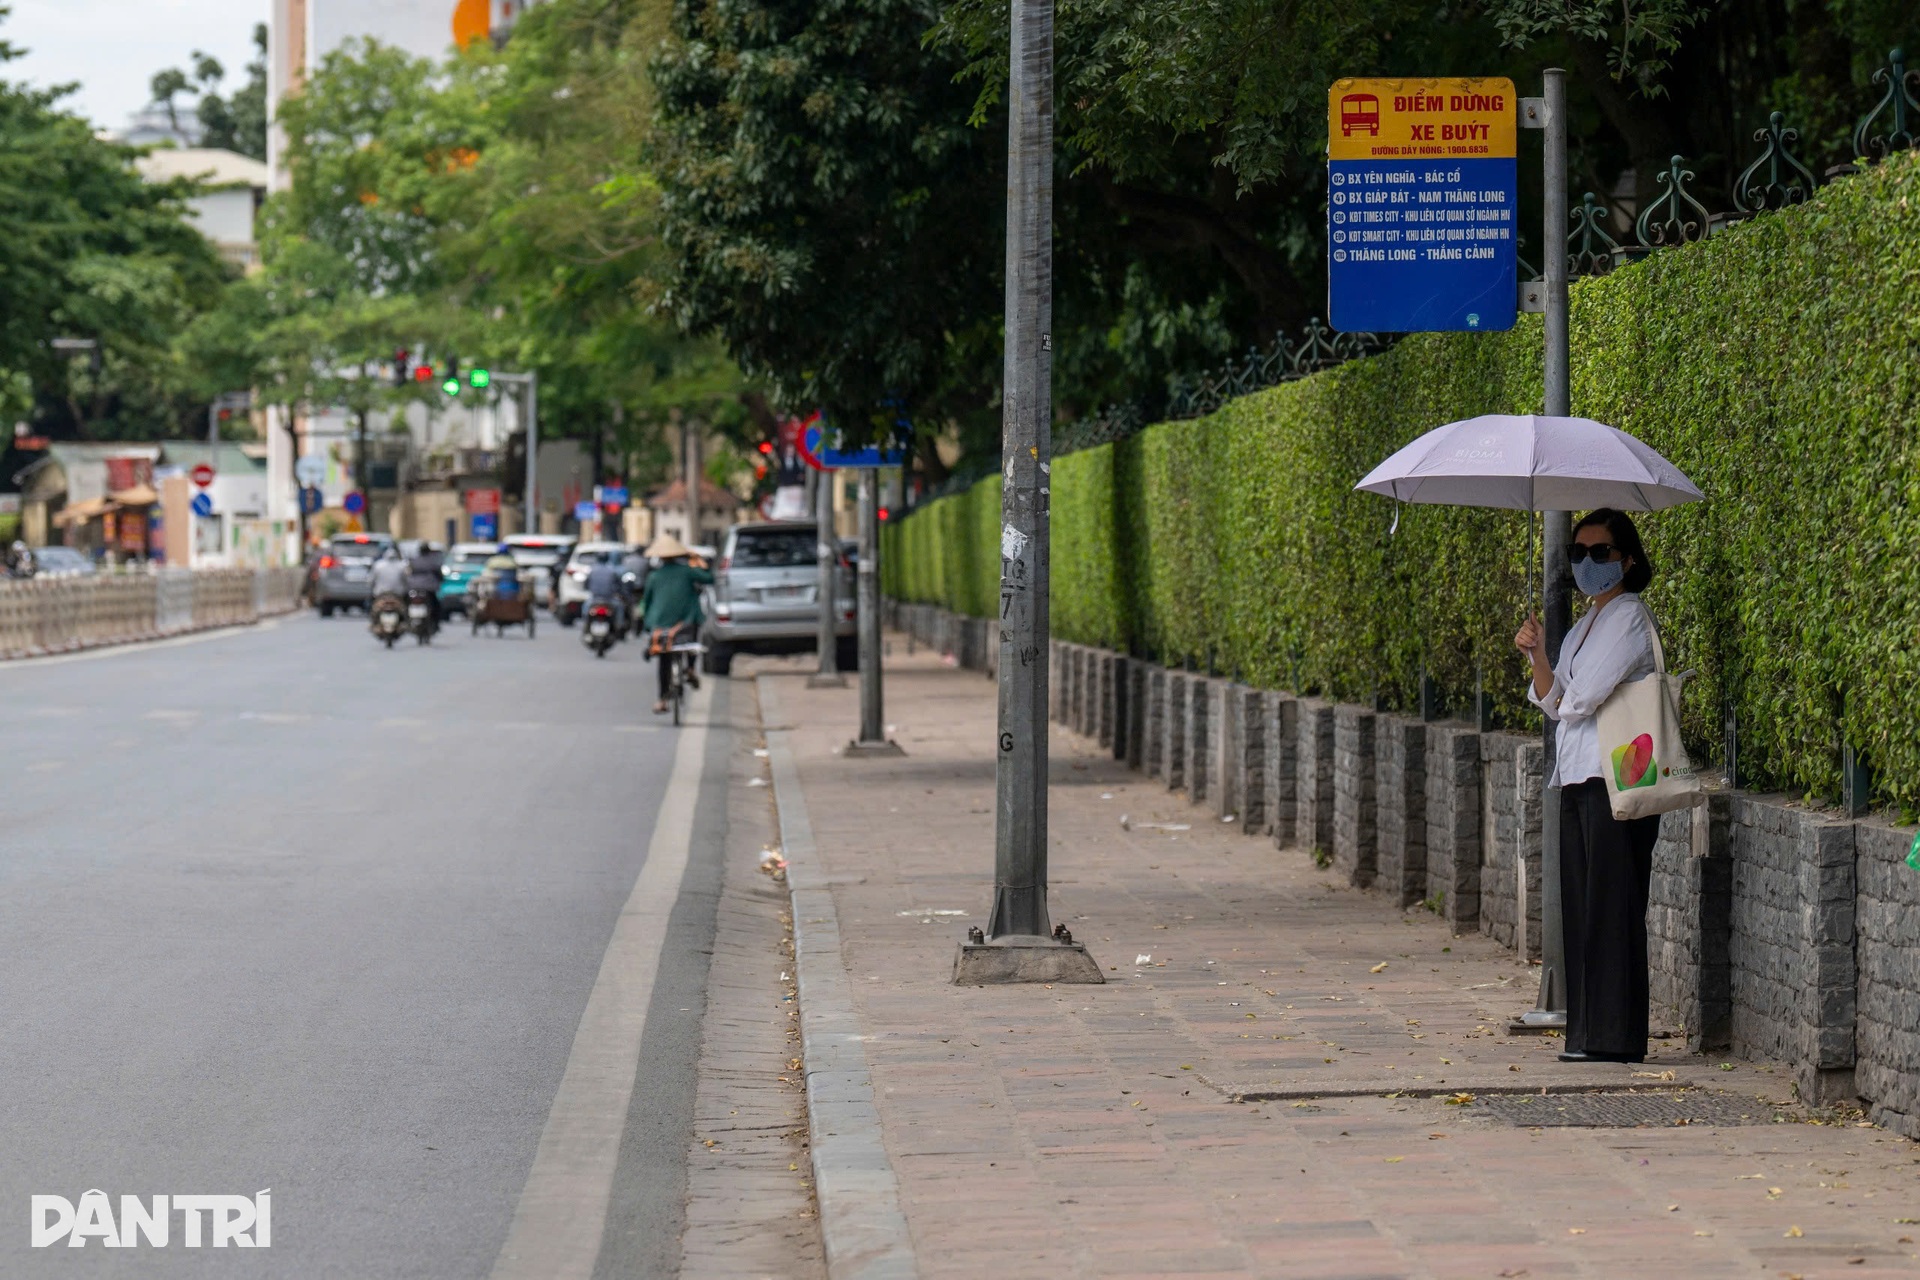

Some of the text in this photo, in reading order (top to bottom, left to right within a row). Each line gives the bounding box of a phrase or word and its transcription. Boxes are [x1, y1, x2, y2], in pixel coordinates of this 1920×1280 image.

[1394, 88, 1444, 112] ĐIỂM
[1410, 120, 1490, 141] XE BUÝT
[1371, 144, 1489, 155] ĐƯỜNG DÂY NÓNG: 1900.6836
[1348, 173, 1361, 184] BX
[1364, 170, 1383, 184] YÊN
[1385, 170, 1416, 184] NGHĨA
[1425, 169, 1445, 183] BÁC
[1447, 167, 1461, 183] CỔ
[1349, 192, 1362, 204] BX
[1365, 188, 1388, 204] GIÁP
[1390, 188, 1409, 204] BÁT
[1419, 191, 1442, 203] NAM
[1444, 188, 1477, 203] THĂNG
[1479, 190, 1505, 203] LONG
[1363, 211, 1384, 222] TIMES
[1385, 210, 1399, 222] CITY
[1405, 210, 1419, 222] KHU
[1419, 208, 1435, 221] LIÊN
[1436, 209, 1446, 222] CƠ
[1446, 209, 1465, 222] QUAN
[1500, 209, 1511, 221] HN
[1362, 230, 1385, 242] SMART
[1386, 230, 1400, 241] CITY
[1405, 229, 1419, 241] KHU
[1420, 227, 1435, 241] LIÊN
[1436, 228, 1446, 241] CƠ
[1446, 228, 1465, 242] QUAN
[1500, 228, 1510, 240] HN
[1349, 247, 1385, 261] THĂNG
[1388, 249, 1416, 261] LONG
[1426, 244, 1462, 260] THẮNG
[1465, 243, 1495, 259] CẢNH
[1000, 732, 1014, 752] G
